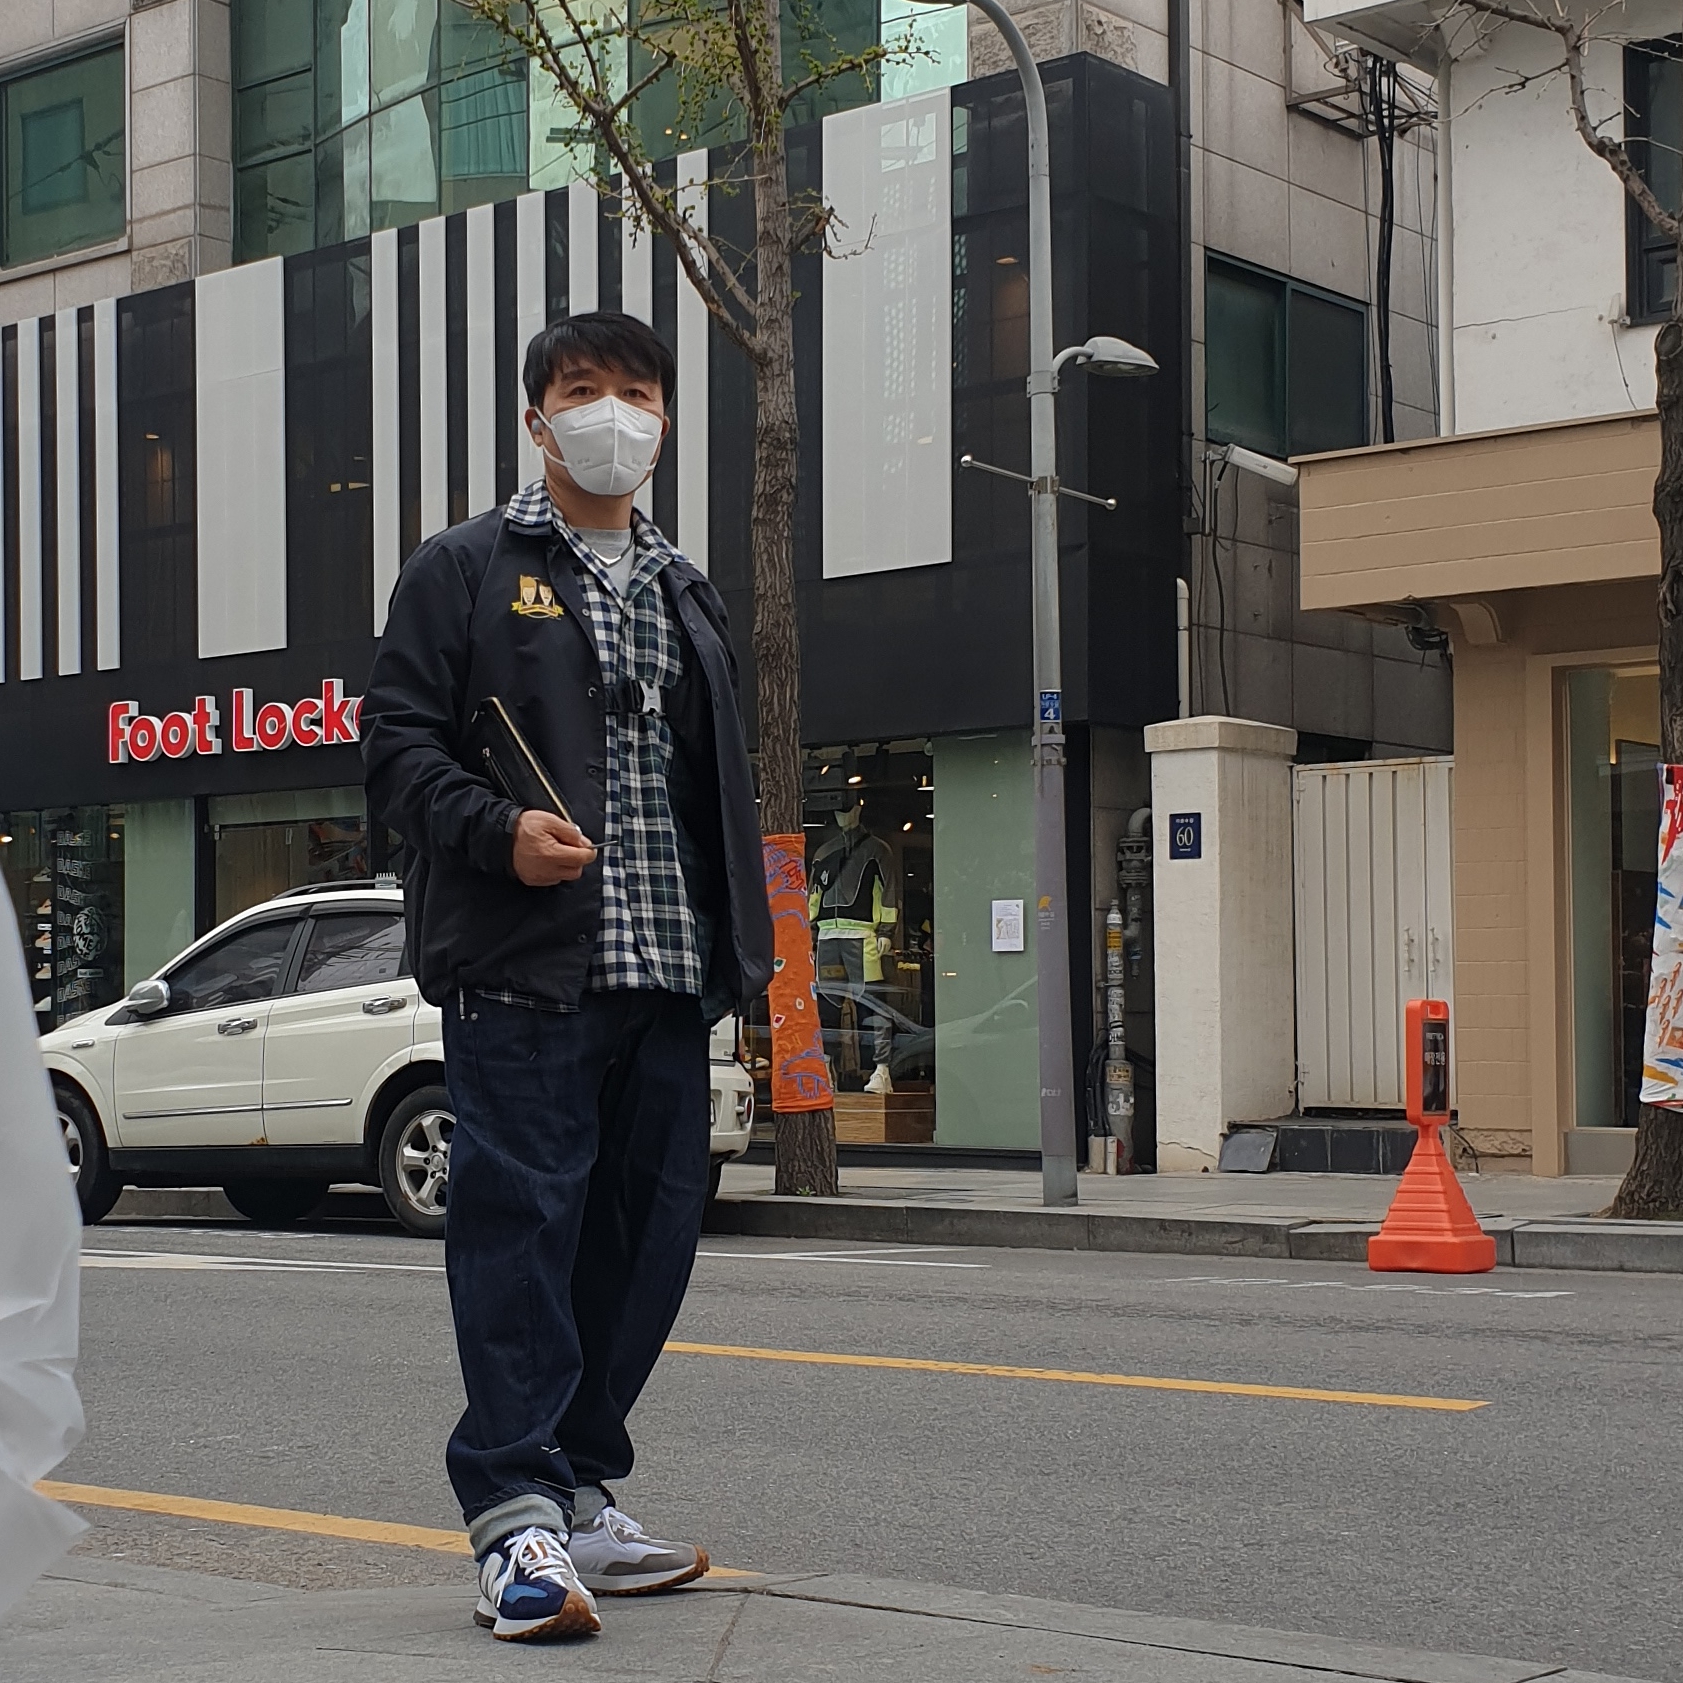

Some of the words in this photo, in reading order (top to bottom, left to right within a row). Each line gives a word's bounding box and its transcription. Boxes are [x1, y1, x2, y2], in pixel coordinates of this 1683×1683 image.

[109, 695, 222, 763] Foot
[233, 678, 364, 751] Lock
[1044, 708, 1056, 720] 4
[1176, 826, 1194, 846] 60
